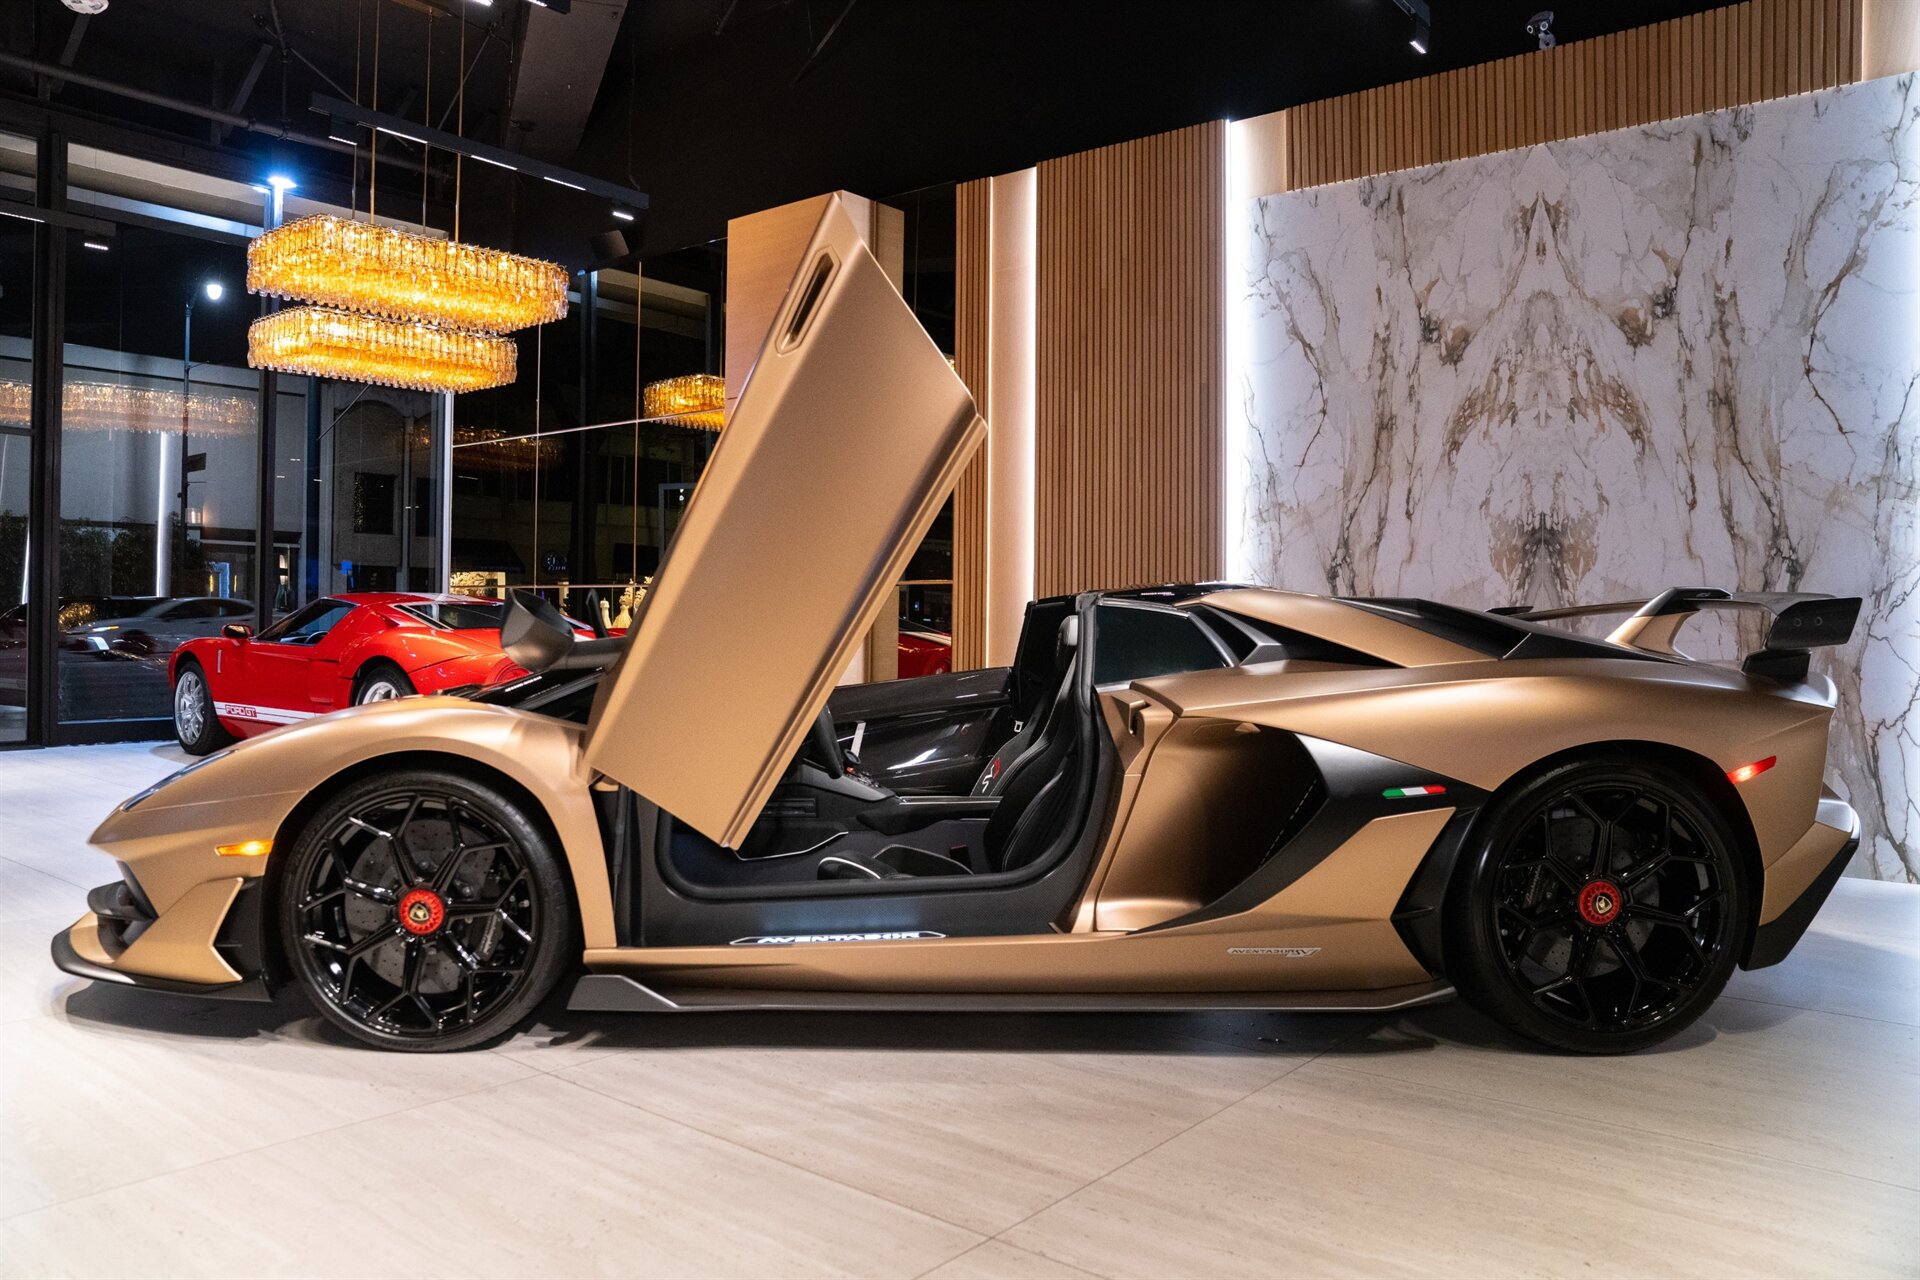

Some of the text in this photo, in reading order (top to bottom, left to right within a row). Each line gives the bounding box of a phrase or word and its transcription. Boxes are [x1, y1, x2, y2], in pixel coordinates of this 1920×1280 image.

[226, 705, 256, 717] FORD GT
[758, 932, 920, 944] AVENTADOR
